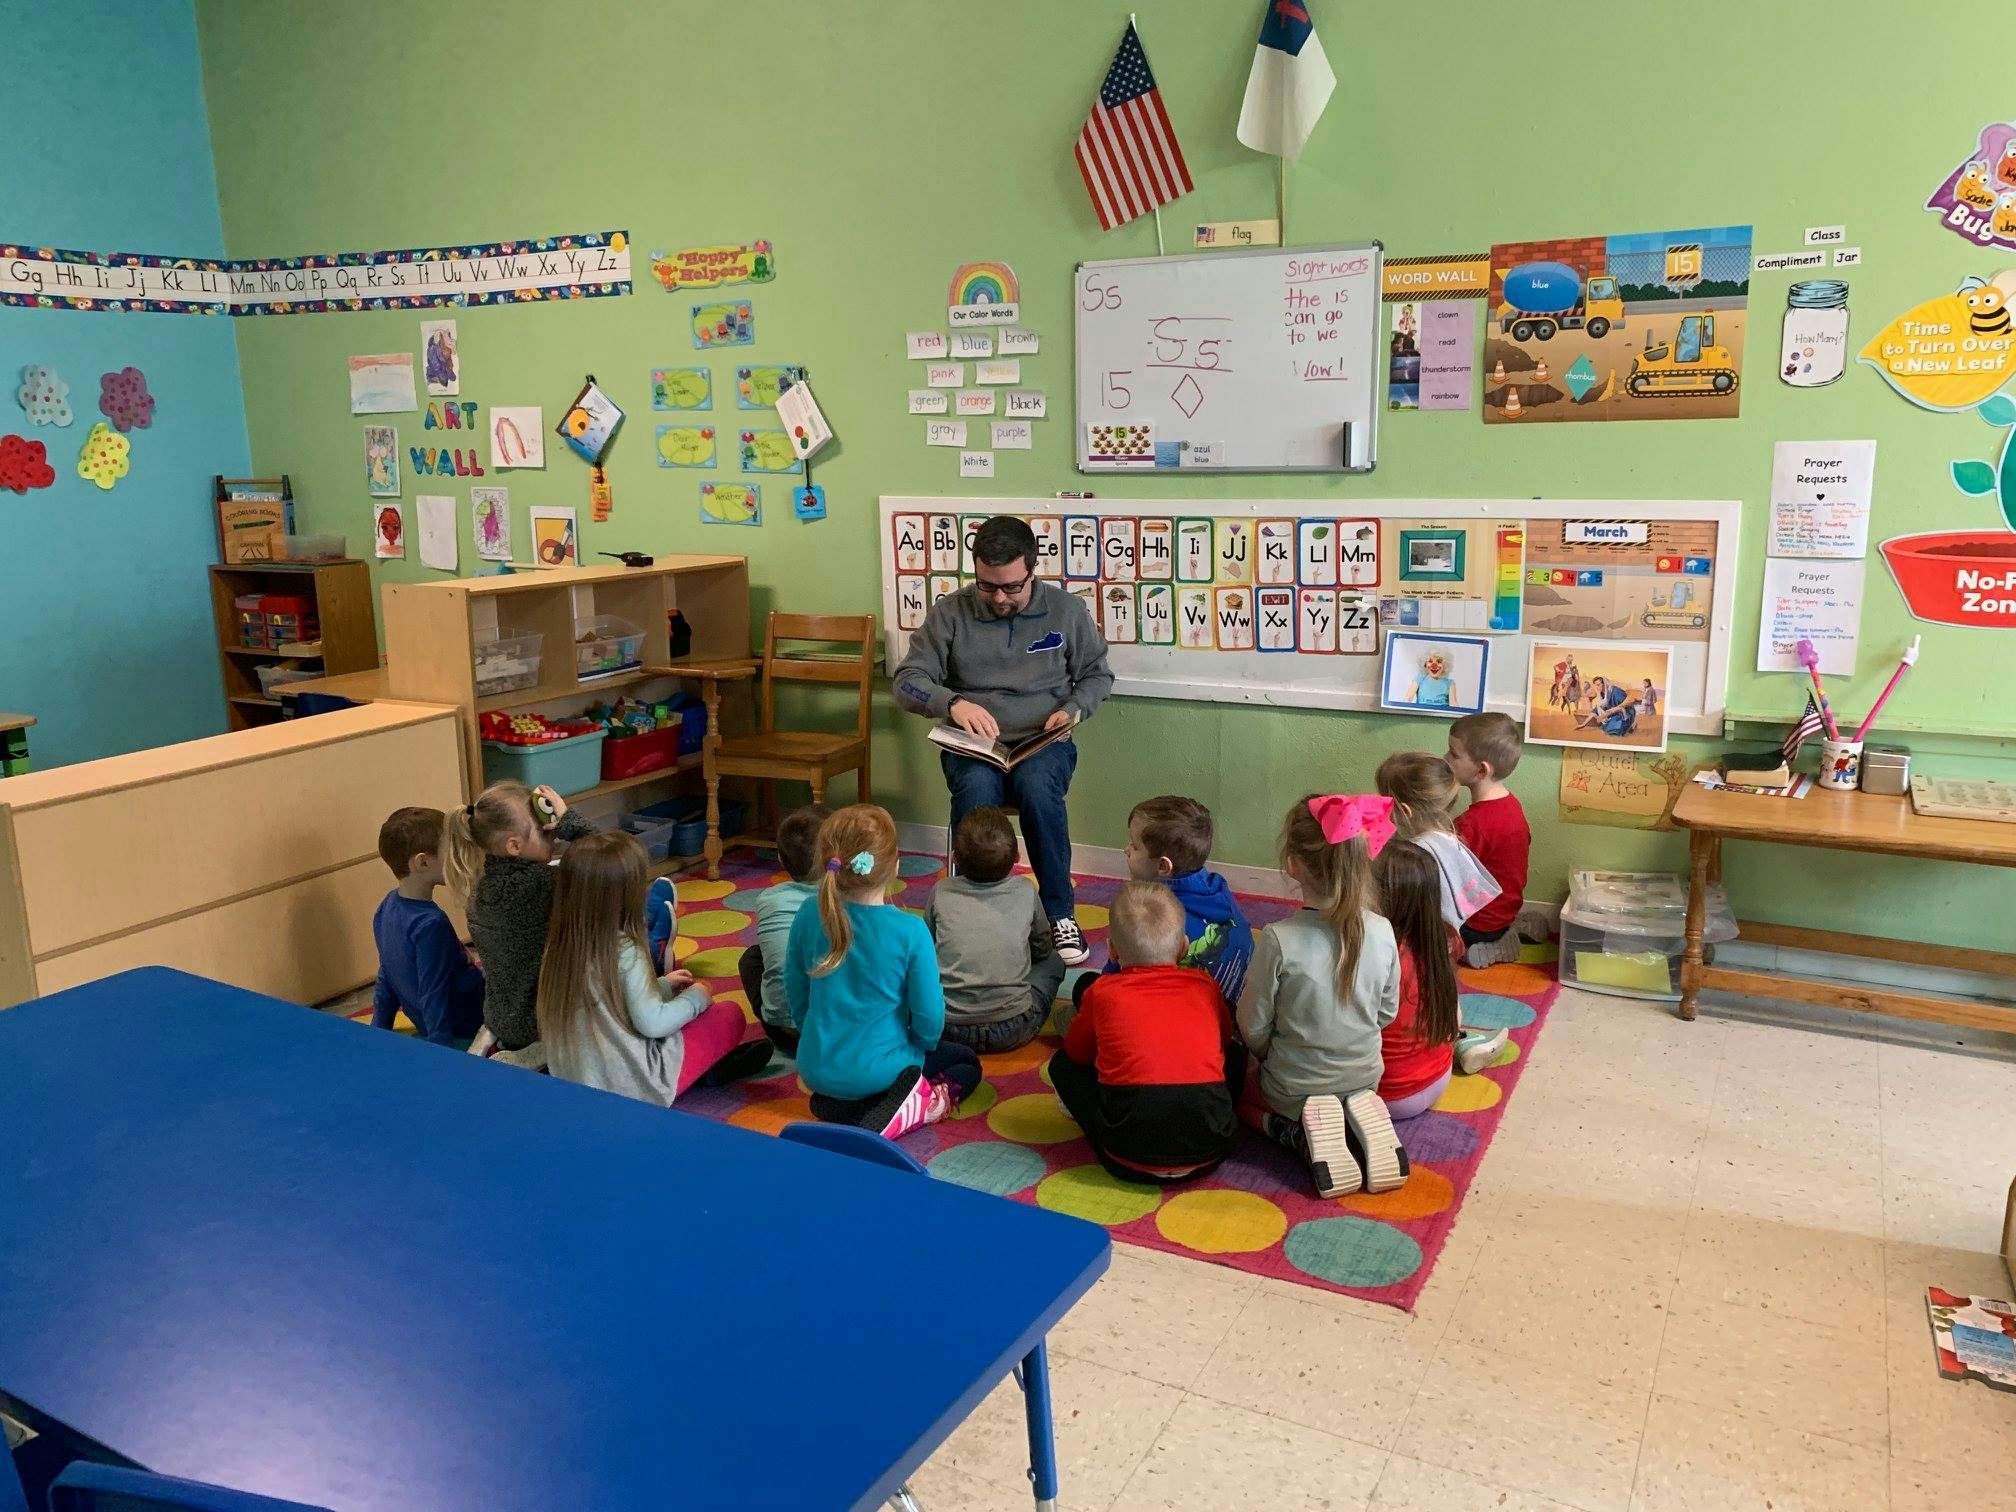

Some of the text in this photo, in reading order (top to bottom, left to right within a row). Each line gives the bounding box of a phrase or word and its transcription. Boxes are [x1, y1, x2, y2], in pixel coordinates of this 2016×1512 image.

[1966, 189, 1993, 206] Sadie
[1232, 226, 1251, 244] flag
[1811, 230, 1840, 241] Class
[1674, 255, 1694, 273] 15
[1758, 253, 1858, 269] Compliment Jar
[11, 249, 617, 297] Gg Hh Ii Jj Kk Ll Mm Nn Oo Pp Qq Rr Ss Tt Uu Vv Ww Xx Yy Zz
[679, 265, 748, 282] Helpers
[1285, 260, 1327, 280] Sight
[1388, 271, 1477, 285] WORD WALL
[1532, 279, 1549, 289] blue
[1082, 274, 1122, 311] Ss
[1284, 288, 1321, 308] the
[953, 309, 1013, 320] Our Color Words
[1285, 310, 1343, 326] can go
[1438, 311, 1458, 319] clown
[1904, 321, 1951, 336] Time
[917, 333, 941, 347] red
[960, 335, 988, 350] blue
[1005, 330, 1036, 344] brown
[1287, 329, 1338, 345] to we
[1795, 332, 1844, 345] How Many?
[1886, 337, 2014, 354] to Turn Over
[1422, 366, 1471, 374] thunderstorm
[1893, 354, 2006, 372] a New Leaf
[931, 368, 956, 383] pink
[1565, 371, 1596, 382] rhombus
[1102, 371, 1132, 409] 15
[1431, 392, 1459, 400] rainbow
[915, 395, 945, 411] green
[960, 396, 992, 410] orange
[1010, 394, 1042, 411] black
[424, 402, 477, 430] ART
[931, 424, 956, 440] gray
[996, 427, 1027, 442] purple
[1115, 427, 1126, 438] 15
[410, 447, 484, 476] WALL
[964, 456, 989, 467] white
[1804, 458, 1842, 469] Prayer
[1797, 475, 1847, 485] Requests
[225, 509, 257, 521] COLORING
[1584, 526, 1628, 538] March
[899, 531, 924, 551] Aa
[934, 531, 955, 550] Bb
[1036, 536, 1058, 557] Ee
[1071, 535, 1094, 557] Ff
[1142, 538, 1169, 558] Hh
[1190, 539, 1199, 555] Ii
[1105, 538, 1134, 566] Gg
[1223, 539, 1246, 562] Jj
[1266, 543, 1287, 560] Kk
[1310, 545, 1327, 563] Ll
[1341, 545, 1375, 563] Mm
[1544, 573, 1549, 581] 3
[1567, 574, 1574, 582] 4
[1799, 572, 1830, 581] Prayer
[1792, 586, 1835, 595] Requests
[904, 595, 922, 610] Nn
[1112, 606, 1126, 620] Tt
[1147, 603, 1167, 619] Uu
[1185, 606, 1206, 624] Vv
[1265, 610, 1287, 627] Xx
[1343, 608, 1369, 629] Zz
[1219, 611, 1250, 628] Ww
[1307, 608, 1329, 633] Yy
[1580, 750, 1640, 771] Quiet
[1599, 772, 1649, 798] Area
